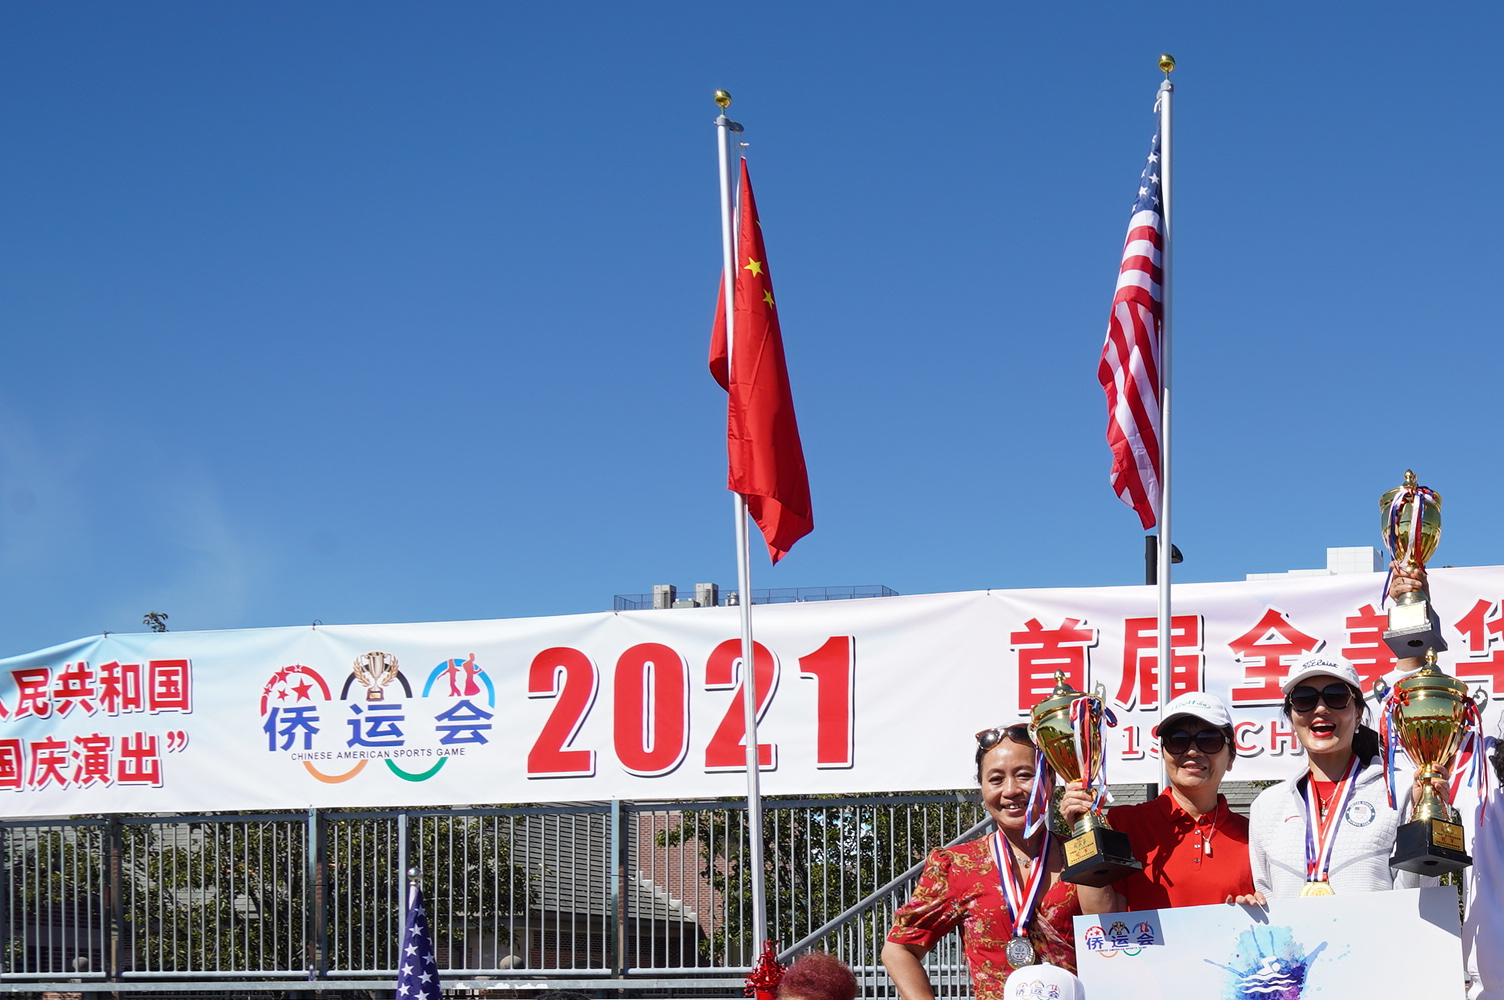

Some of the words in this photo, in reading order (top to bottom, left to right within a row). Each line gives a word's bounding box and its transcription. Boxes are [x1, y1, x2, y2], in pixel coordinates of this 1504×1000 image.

[0, 658, 192, 721] 民共和国
[526, 635, 853, 778] 2021
[262, 699, 495, 752] 侨运会
[291, 751, 333, 761] CHINESE
[336, 750, 391, 760] AMERICAN
[393, 748, 432, 759] SPORTS
[436, 747, 466, 757] GAME
[1086, 932, 1155, 951] 侨运会
